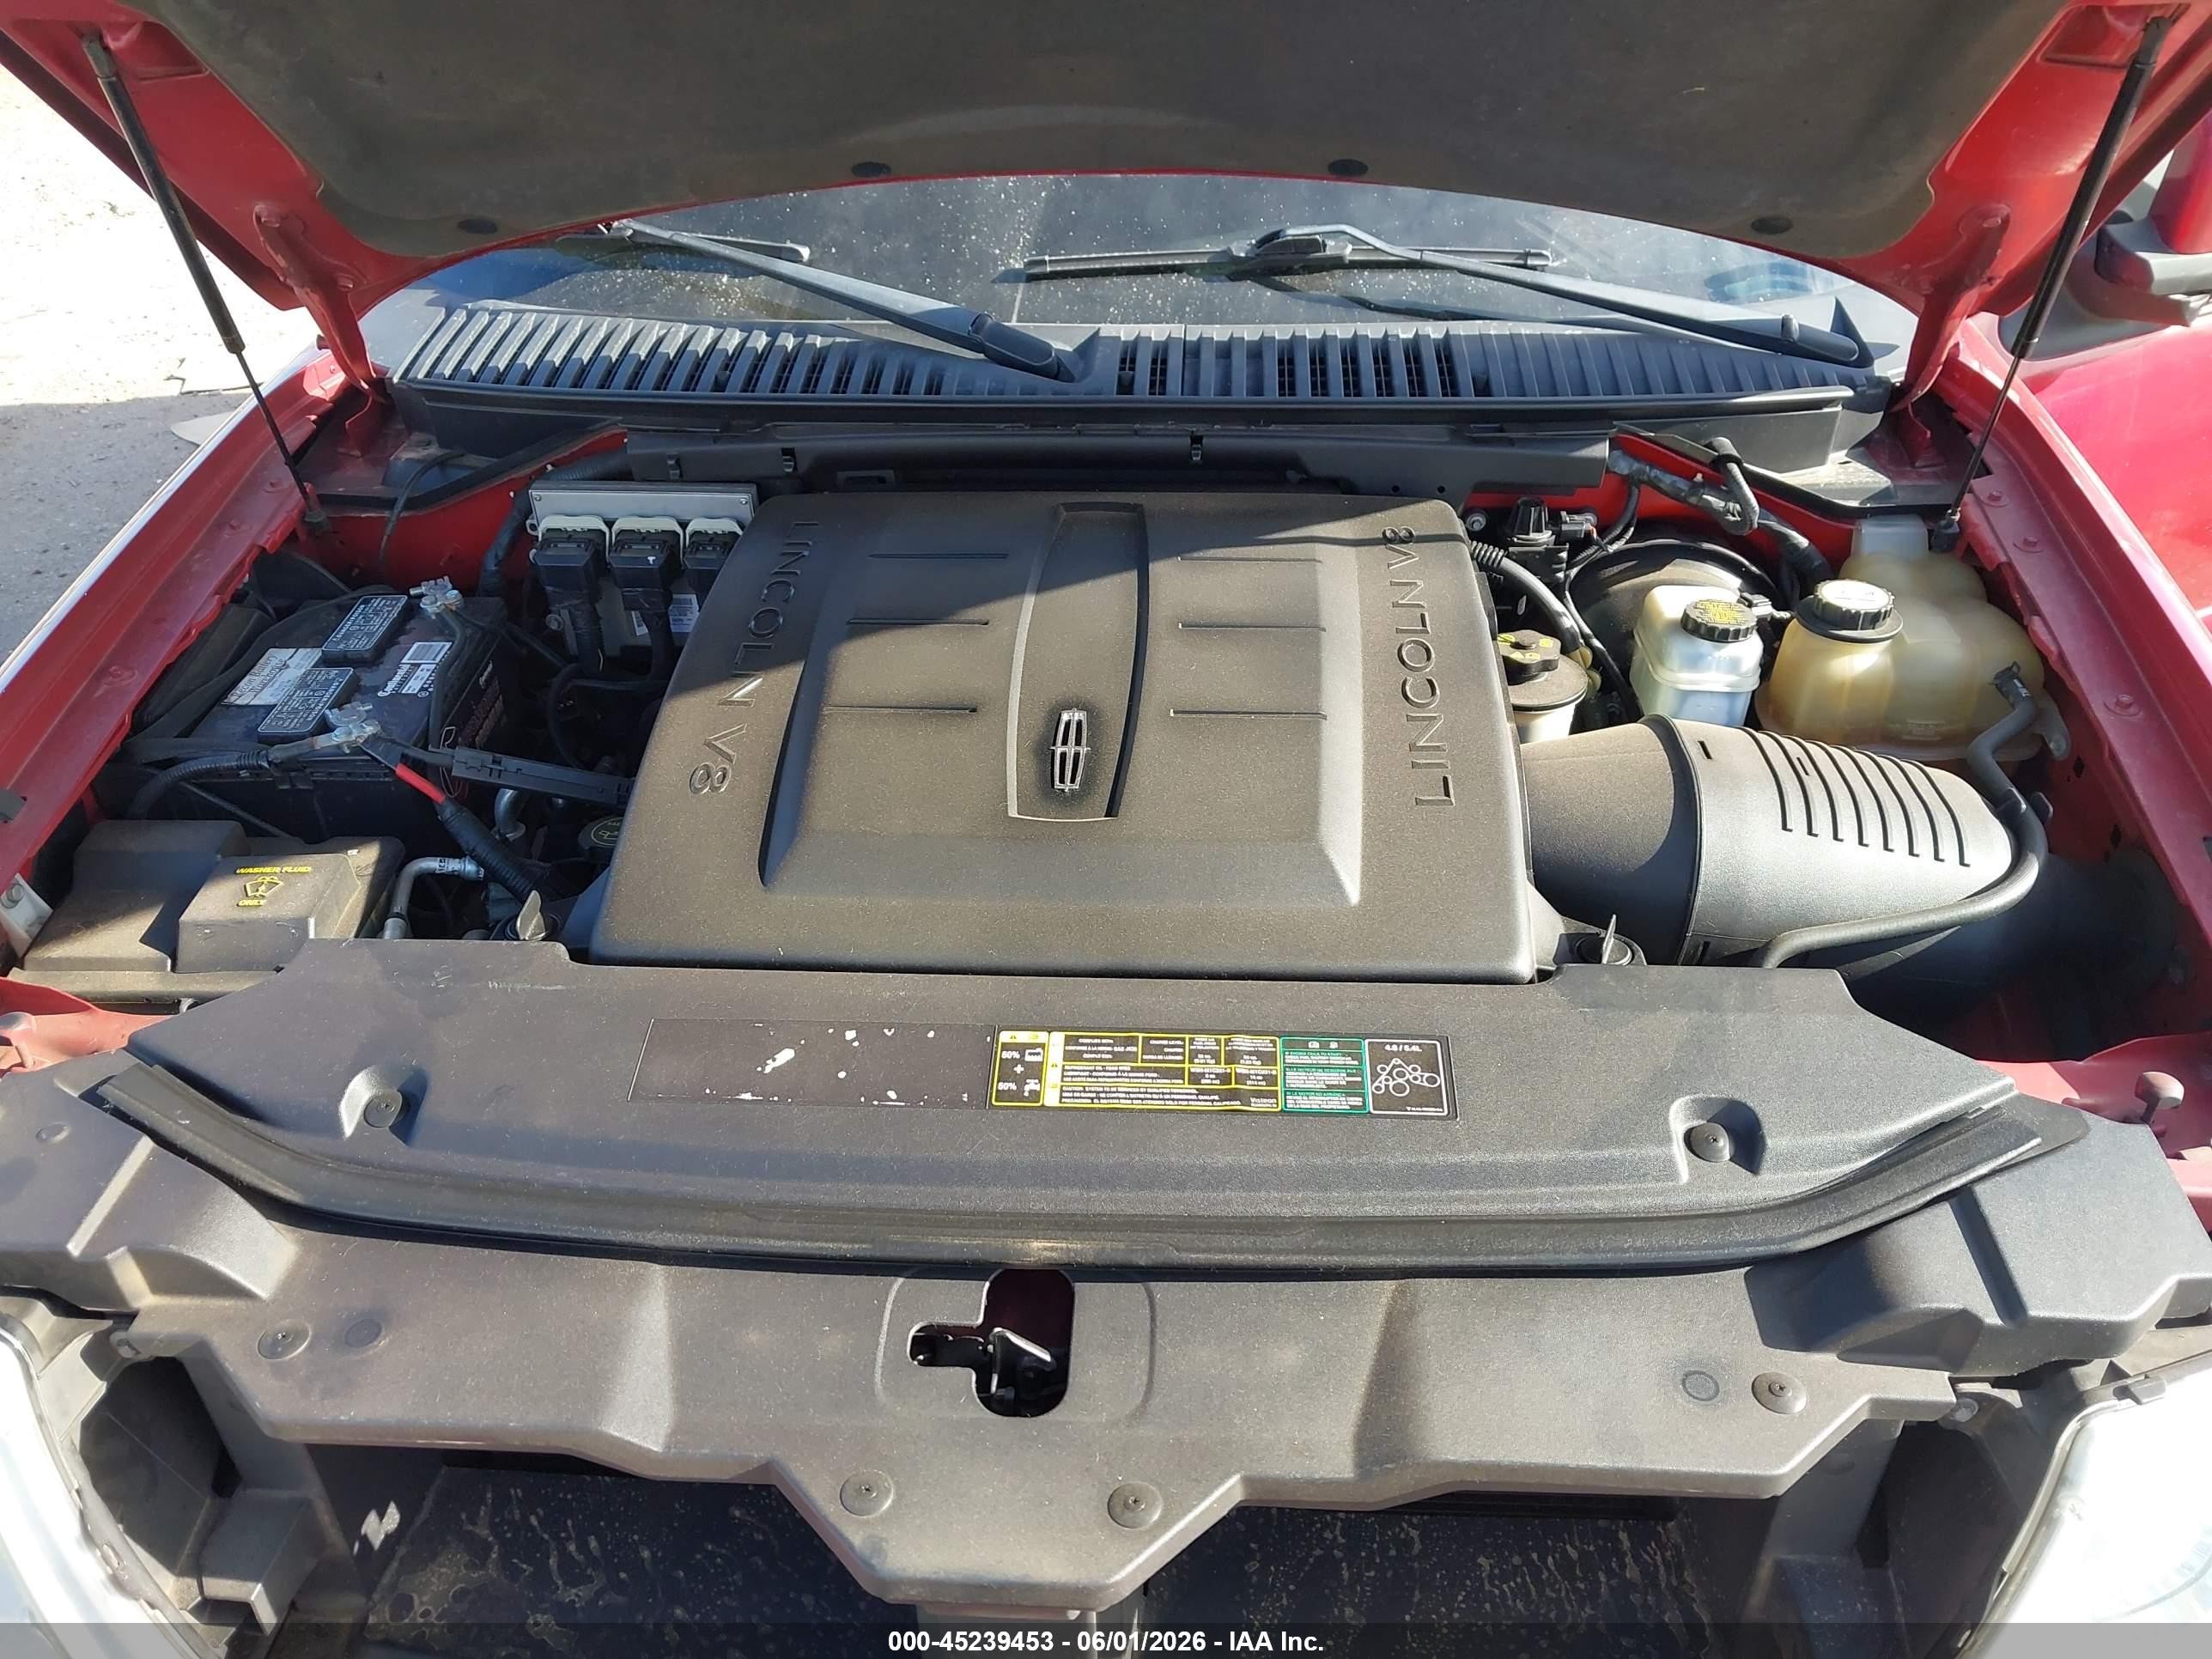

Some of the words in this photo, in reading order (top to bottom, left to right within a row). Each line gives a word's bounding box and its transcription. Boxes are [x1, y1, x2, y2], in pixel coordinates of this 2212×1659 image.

[1382, 526, 1419, 569] V8
[718, 521, 817, 707] LINCOLN
[377, 664, 410, 697] Continental
[1389, 579, 1456, 806] LINCOLN
[690, 723, 747, 794] V8
